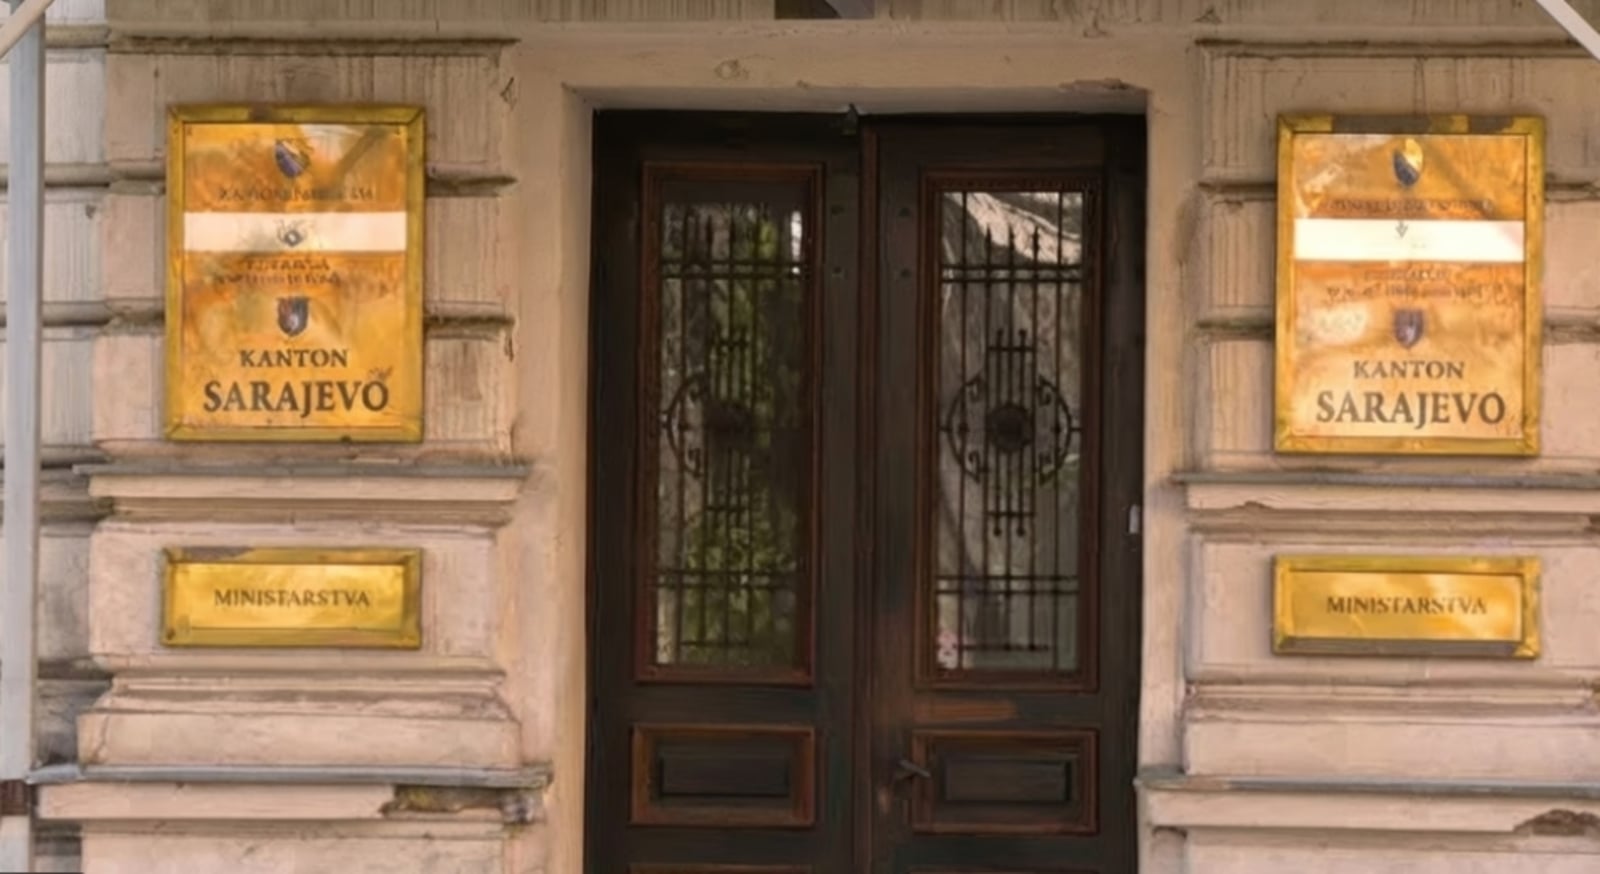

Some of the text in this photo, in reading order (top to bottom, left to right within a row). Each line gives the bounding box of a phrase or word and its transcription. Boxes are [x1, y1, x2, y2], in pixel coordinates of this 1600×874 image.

[239, 348, 349, 368] KANTON
[1353, 360, 1465, 379] KANTON
[203, 380, 390, 418] SARAJEVO
[1316, 391, 1506, 429] SARAJEVO
[214, 588, 370, 608] MINISTARSTVA
[1326, 595, 1488, 615] MINISTARSTVA
